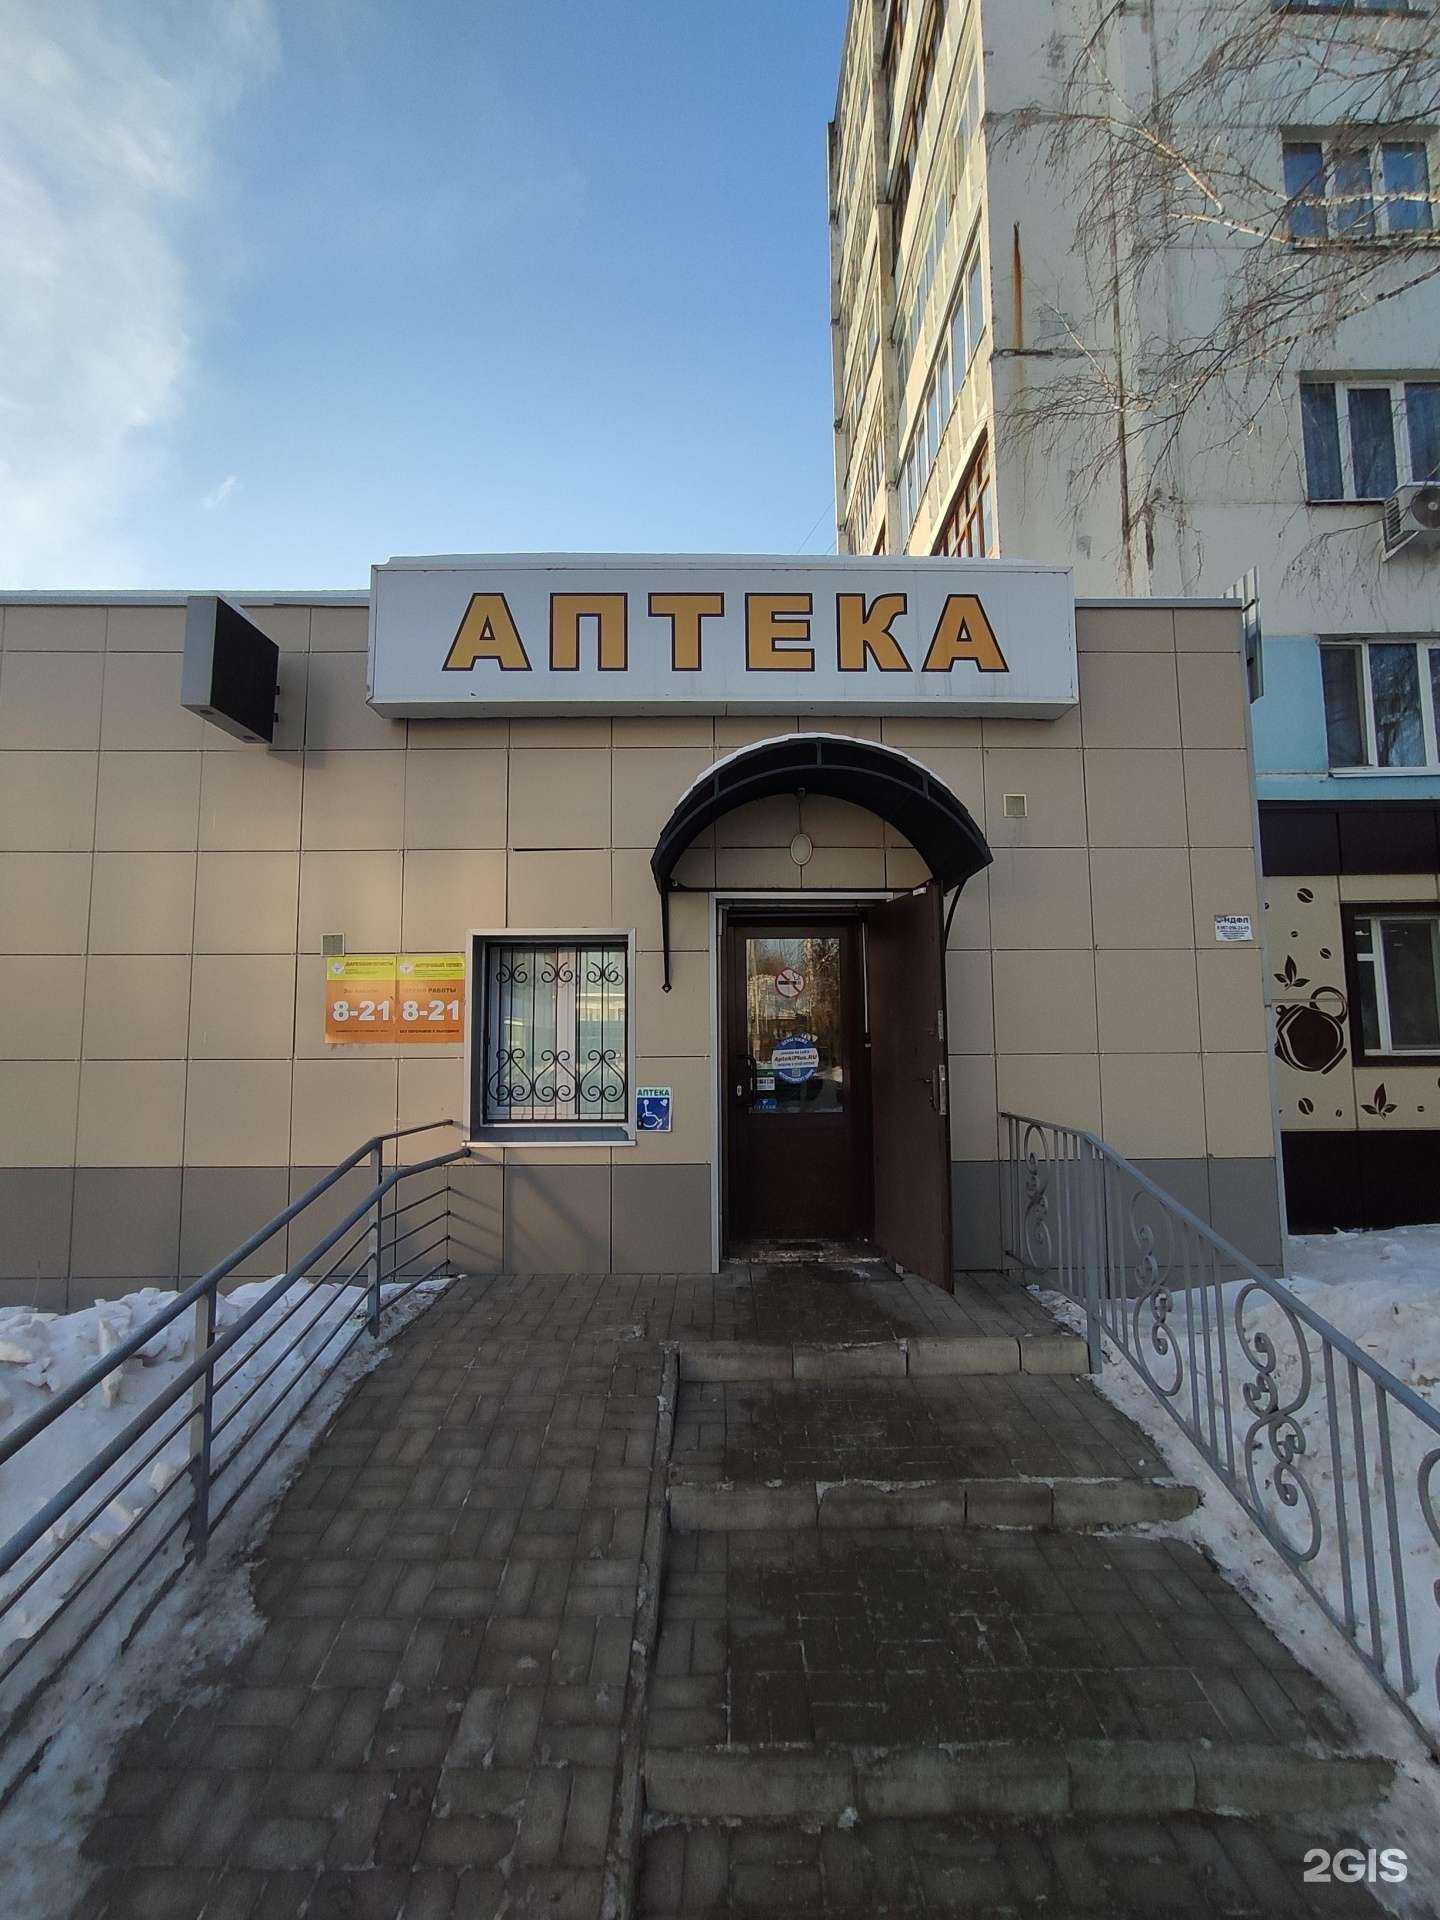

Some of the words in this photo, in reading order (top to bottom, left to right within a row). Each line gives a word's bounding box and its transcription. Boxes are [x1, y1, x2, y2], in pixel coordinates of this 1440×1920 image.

[441, 592, 1010, 673] АПТЕКА
[332, 1000, 390, 1021] 8-21
[402, 1000, 459, 1021] 8-21
[637, 1088, 670, 1096] АПТЕКА
